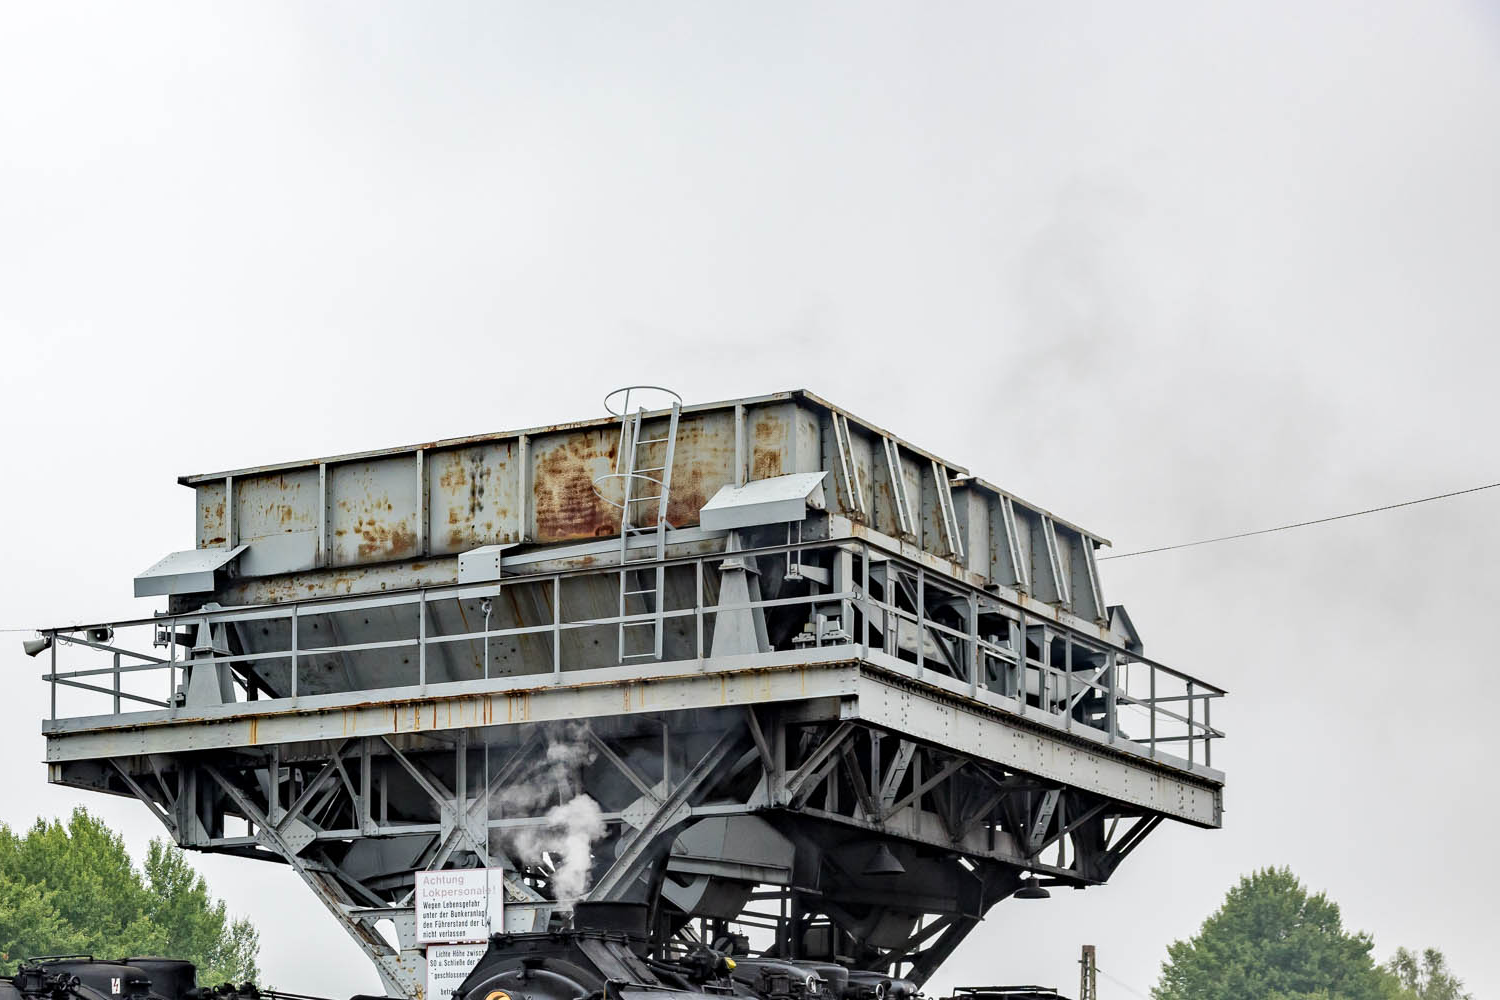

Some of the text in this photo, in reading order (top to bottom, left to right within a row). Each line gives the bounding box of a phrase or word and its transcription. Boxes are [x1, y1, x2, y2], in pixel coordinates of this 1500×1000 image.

[423, 876, 464, 886] Achtung
[423, 900, 480, 910] Wegen Lebensgefahr
[423, 911, 438, 919] unter
[434, 920, 469, 928] Führerstand
[439, 930, 466, 938] verlassen
[435, 950, 451, 958] Lichte
